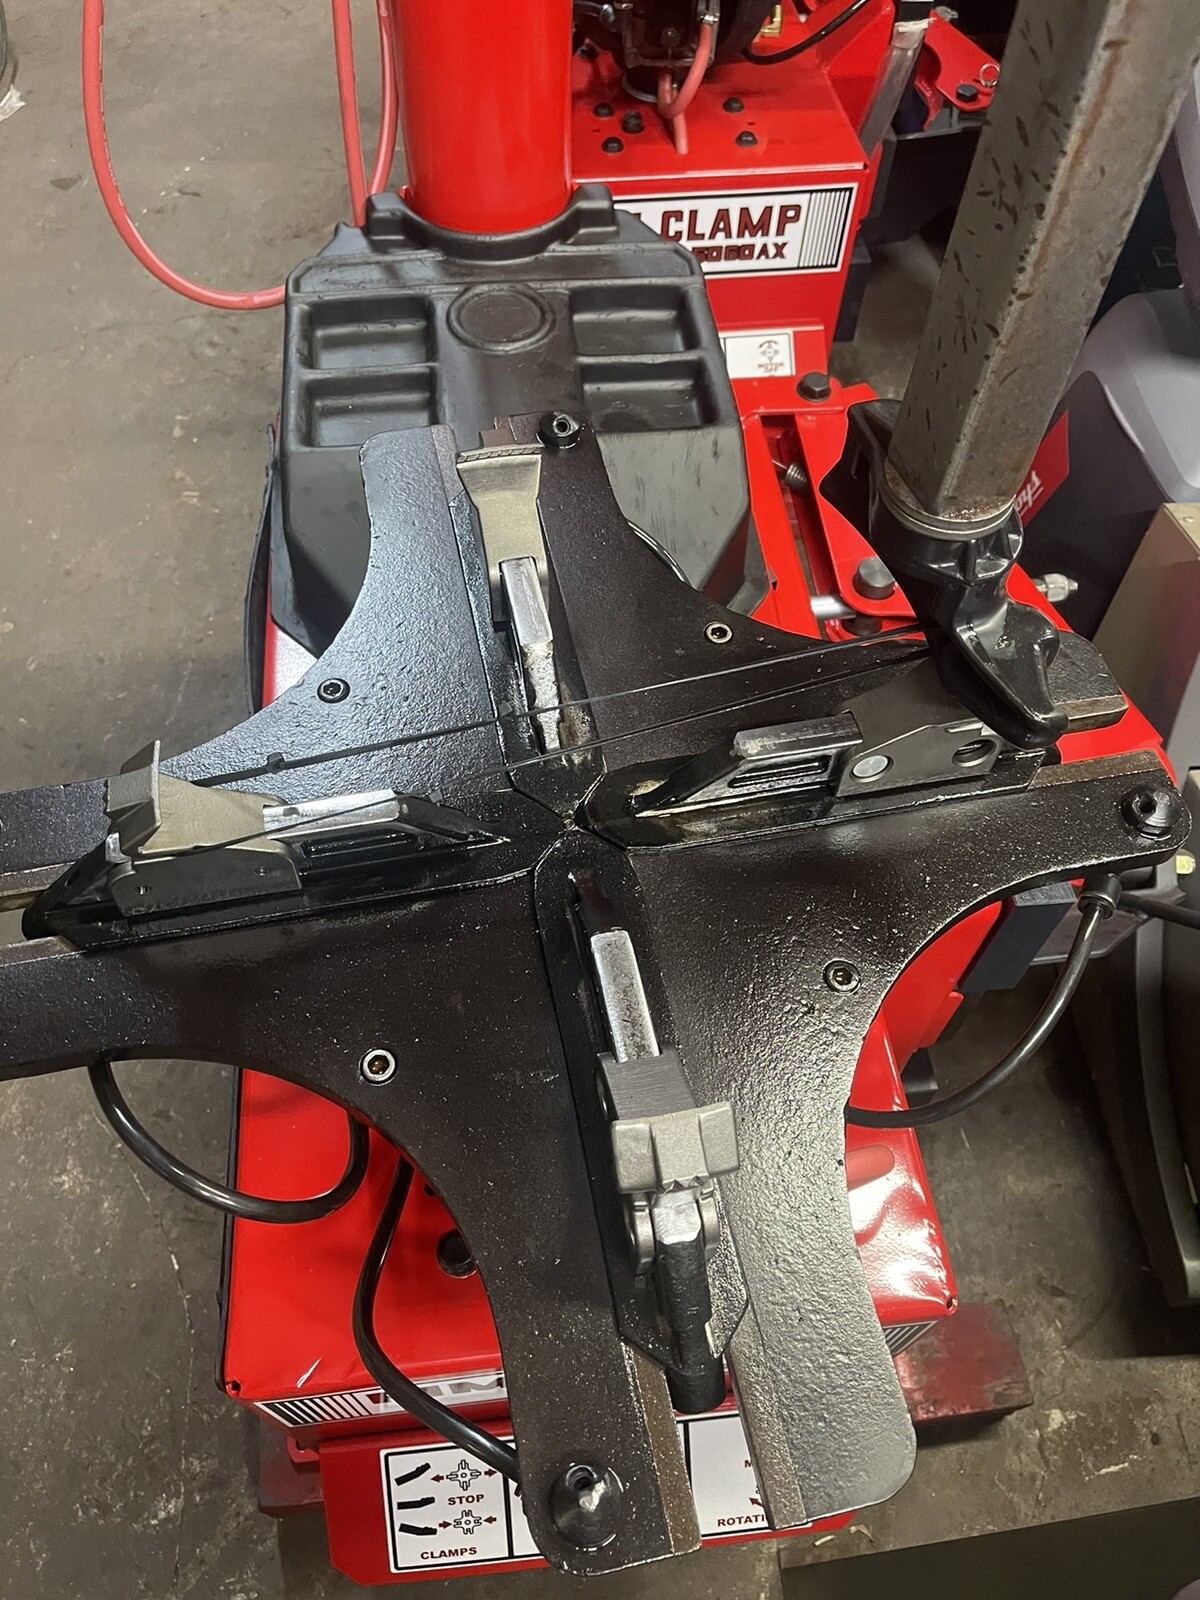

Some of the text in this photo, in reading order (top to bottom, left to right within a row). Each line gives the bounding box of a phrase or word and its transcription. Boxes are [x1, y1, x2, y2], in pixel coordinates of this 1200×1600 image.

[661, 204, 802, 243] CLAMP
[447, 1494, 485, 1506] STOP
[717, 1513, 768, 1527] ROTATI
[420, 1547, 478, 1560] CLAMPS
